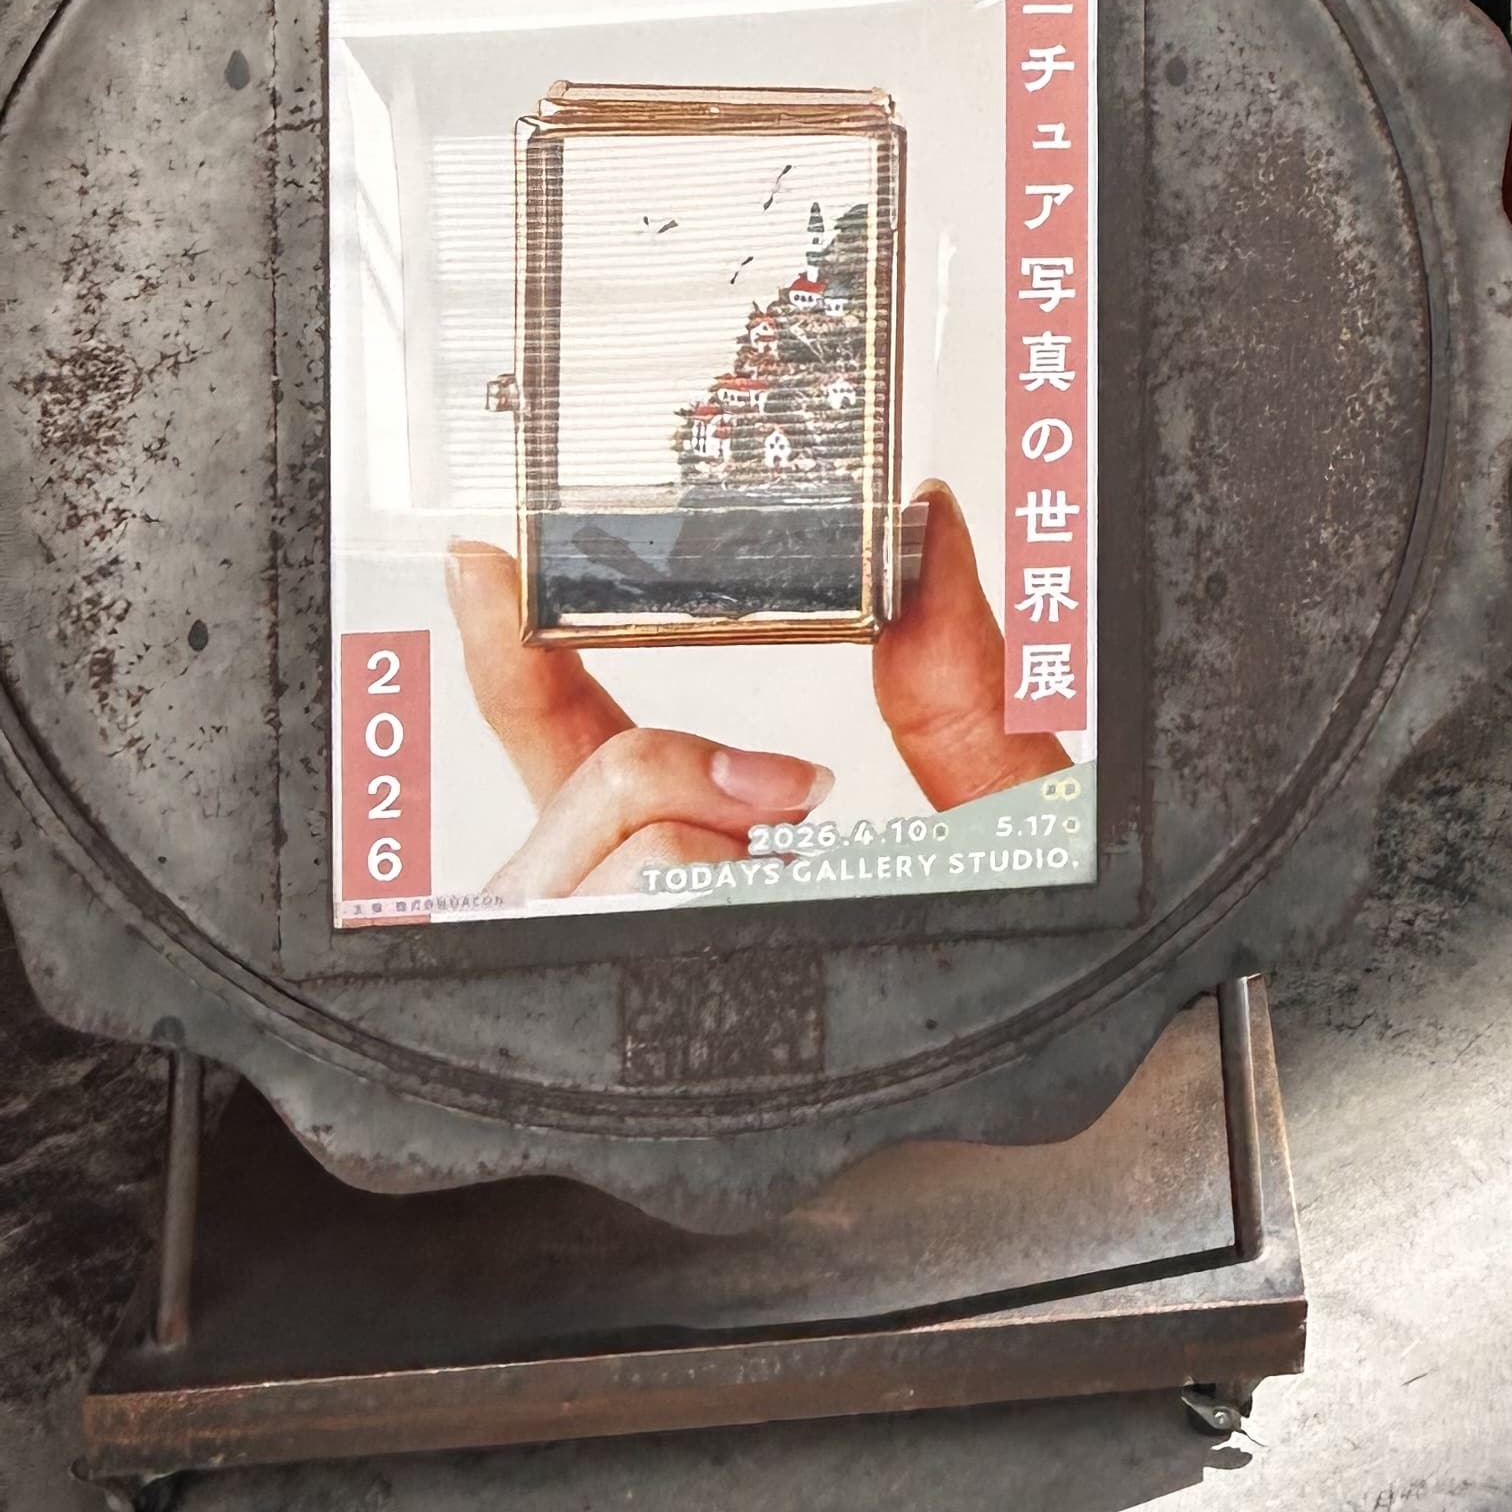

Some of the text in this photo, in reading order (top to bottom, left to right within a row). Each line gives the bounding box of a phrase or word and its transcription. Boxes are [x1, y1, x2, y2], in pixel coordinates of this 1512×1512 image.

[363, 648, 404, 883] 2026
[642, 863, 780, 892] TODAYS
[792, 854, 937, 882] GALLERY
